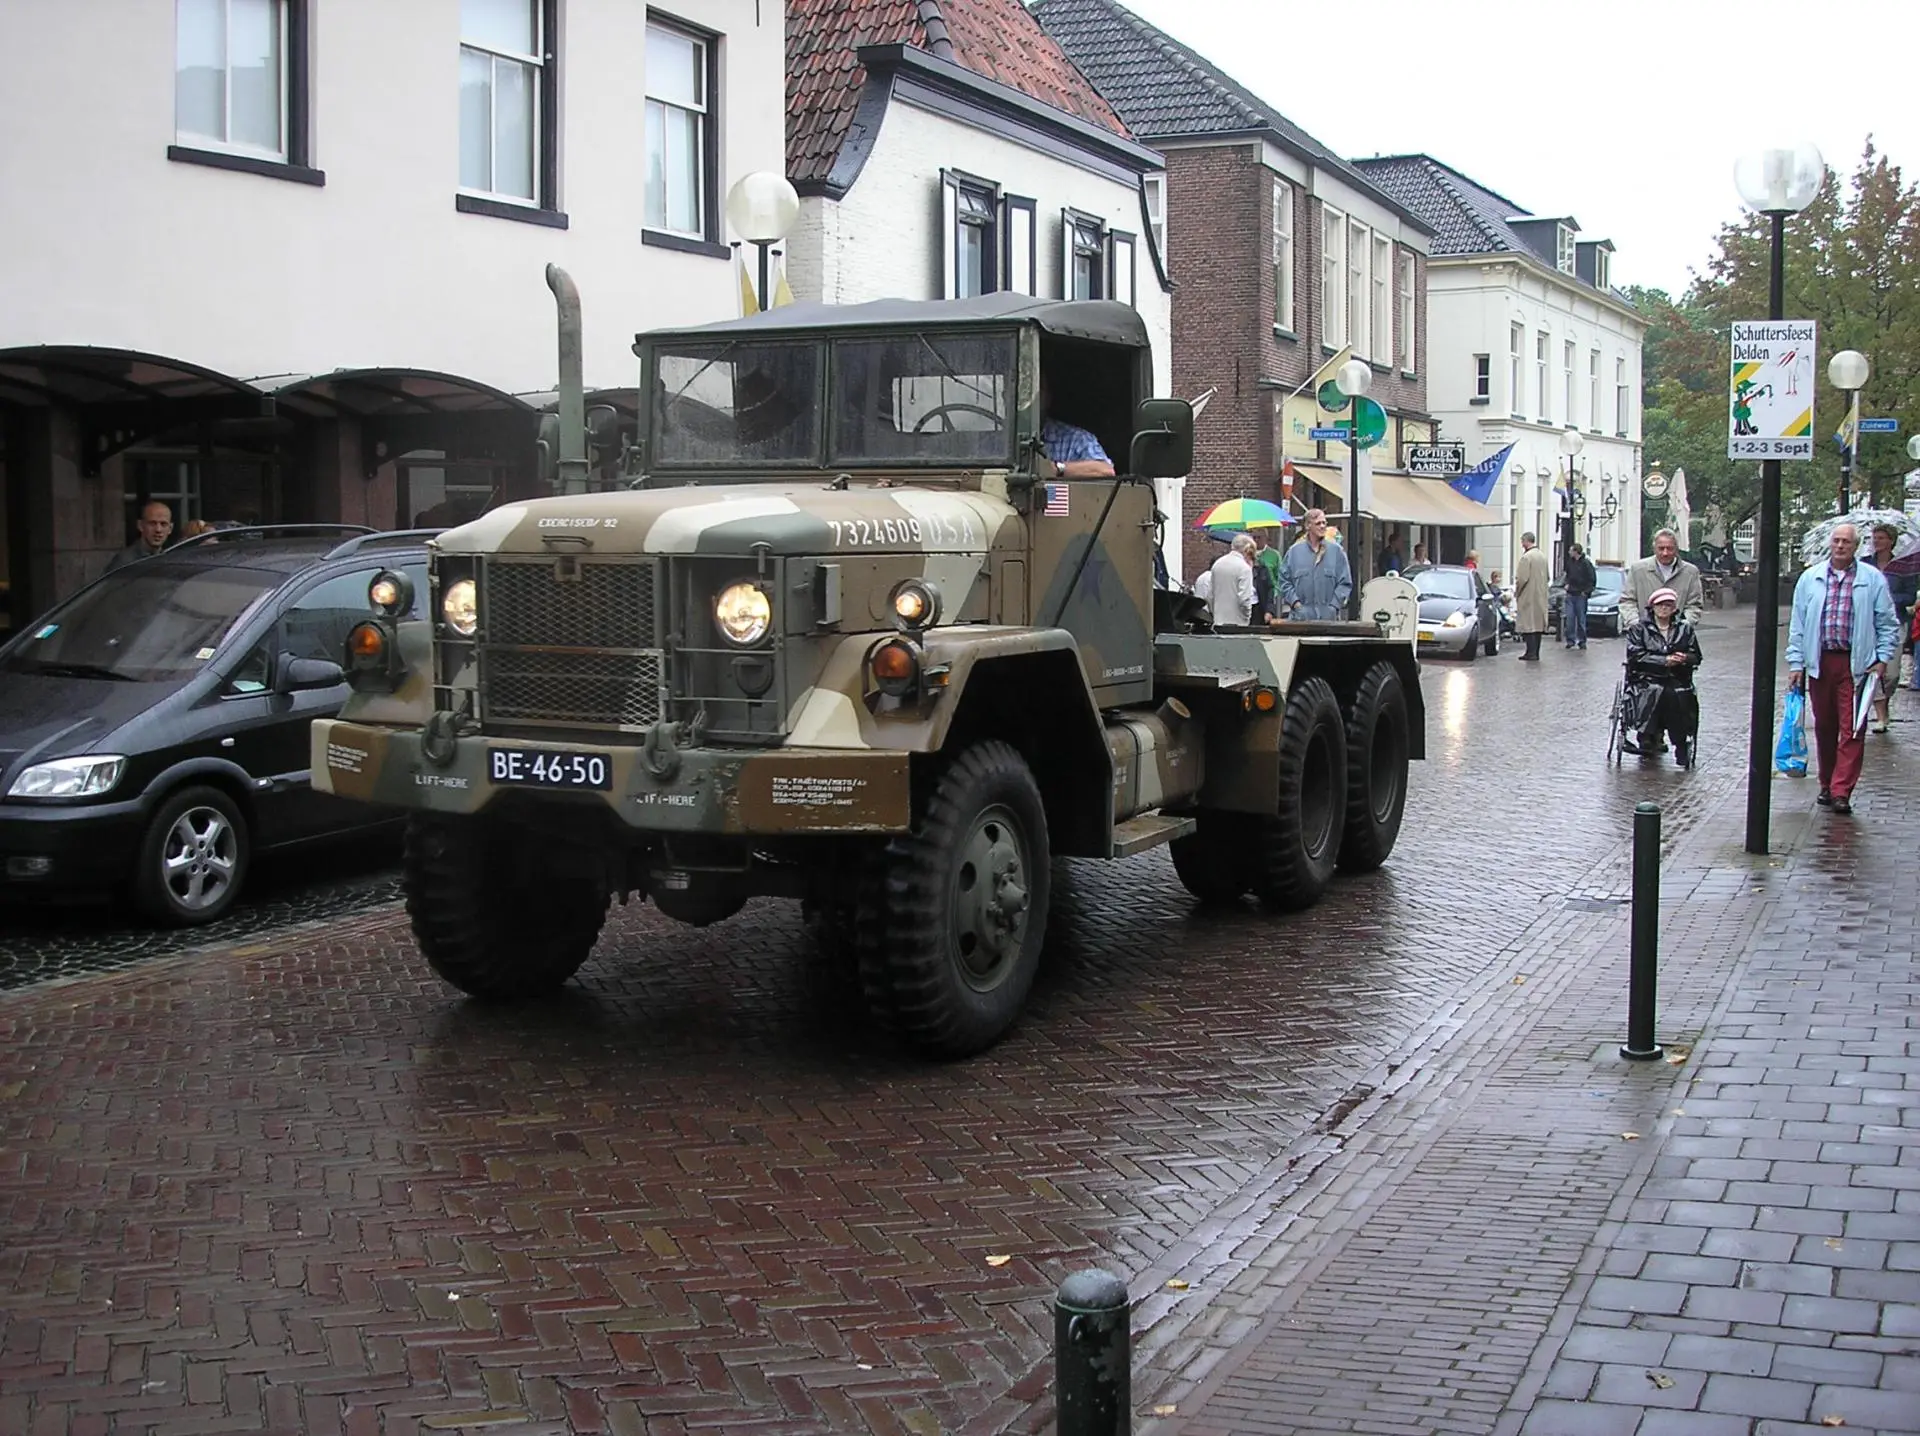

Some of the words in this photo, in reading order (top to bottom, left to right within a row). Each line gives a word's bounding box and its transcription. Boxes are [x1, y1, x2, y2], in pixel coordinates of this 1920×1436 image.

[1733, 324, 1813, 341] Schuttersfeest
[1733, 344, 1770, 360] Delden
[1416, 449, 1454, 458] OPTIEK
[1732, 442, 1769, 454] 1-2-3
[1774, 442, 1810, 456] Sept
[1415, 463, 1456, 471] AARSEN
[827, 517, 922, 546] 7324609
[926, 513, 976, 545] USA
[493, 751, 605, 785] BE-46-50
